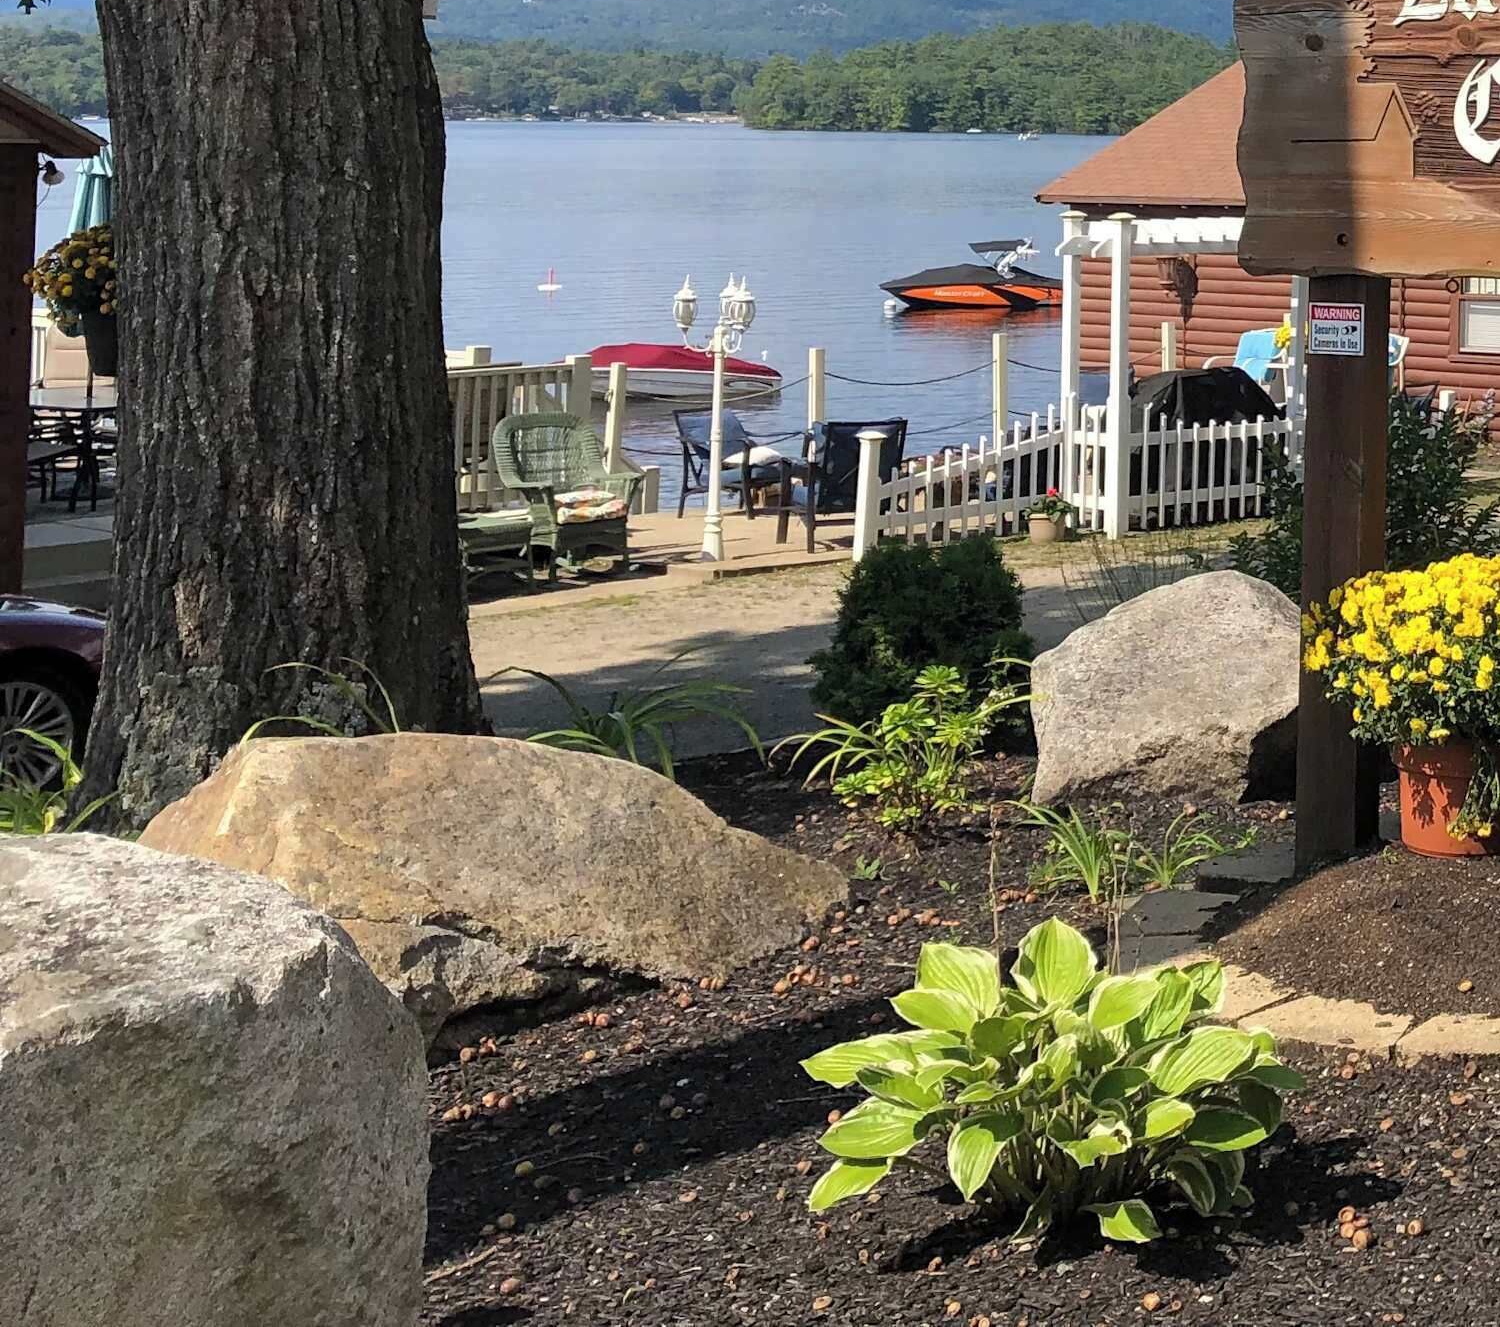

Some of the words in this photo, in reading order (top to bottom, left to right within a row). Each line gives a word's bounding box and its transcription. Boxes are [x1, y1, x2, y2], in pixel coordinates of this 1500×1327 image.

[1314, 307, 1360, 320] WARNING
[1314, 324, 1339, 337] Security
[1314, 337, 1338, 349] Cameras
[1347, 338, 1358, 349] Use
